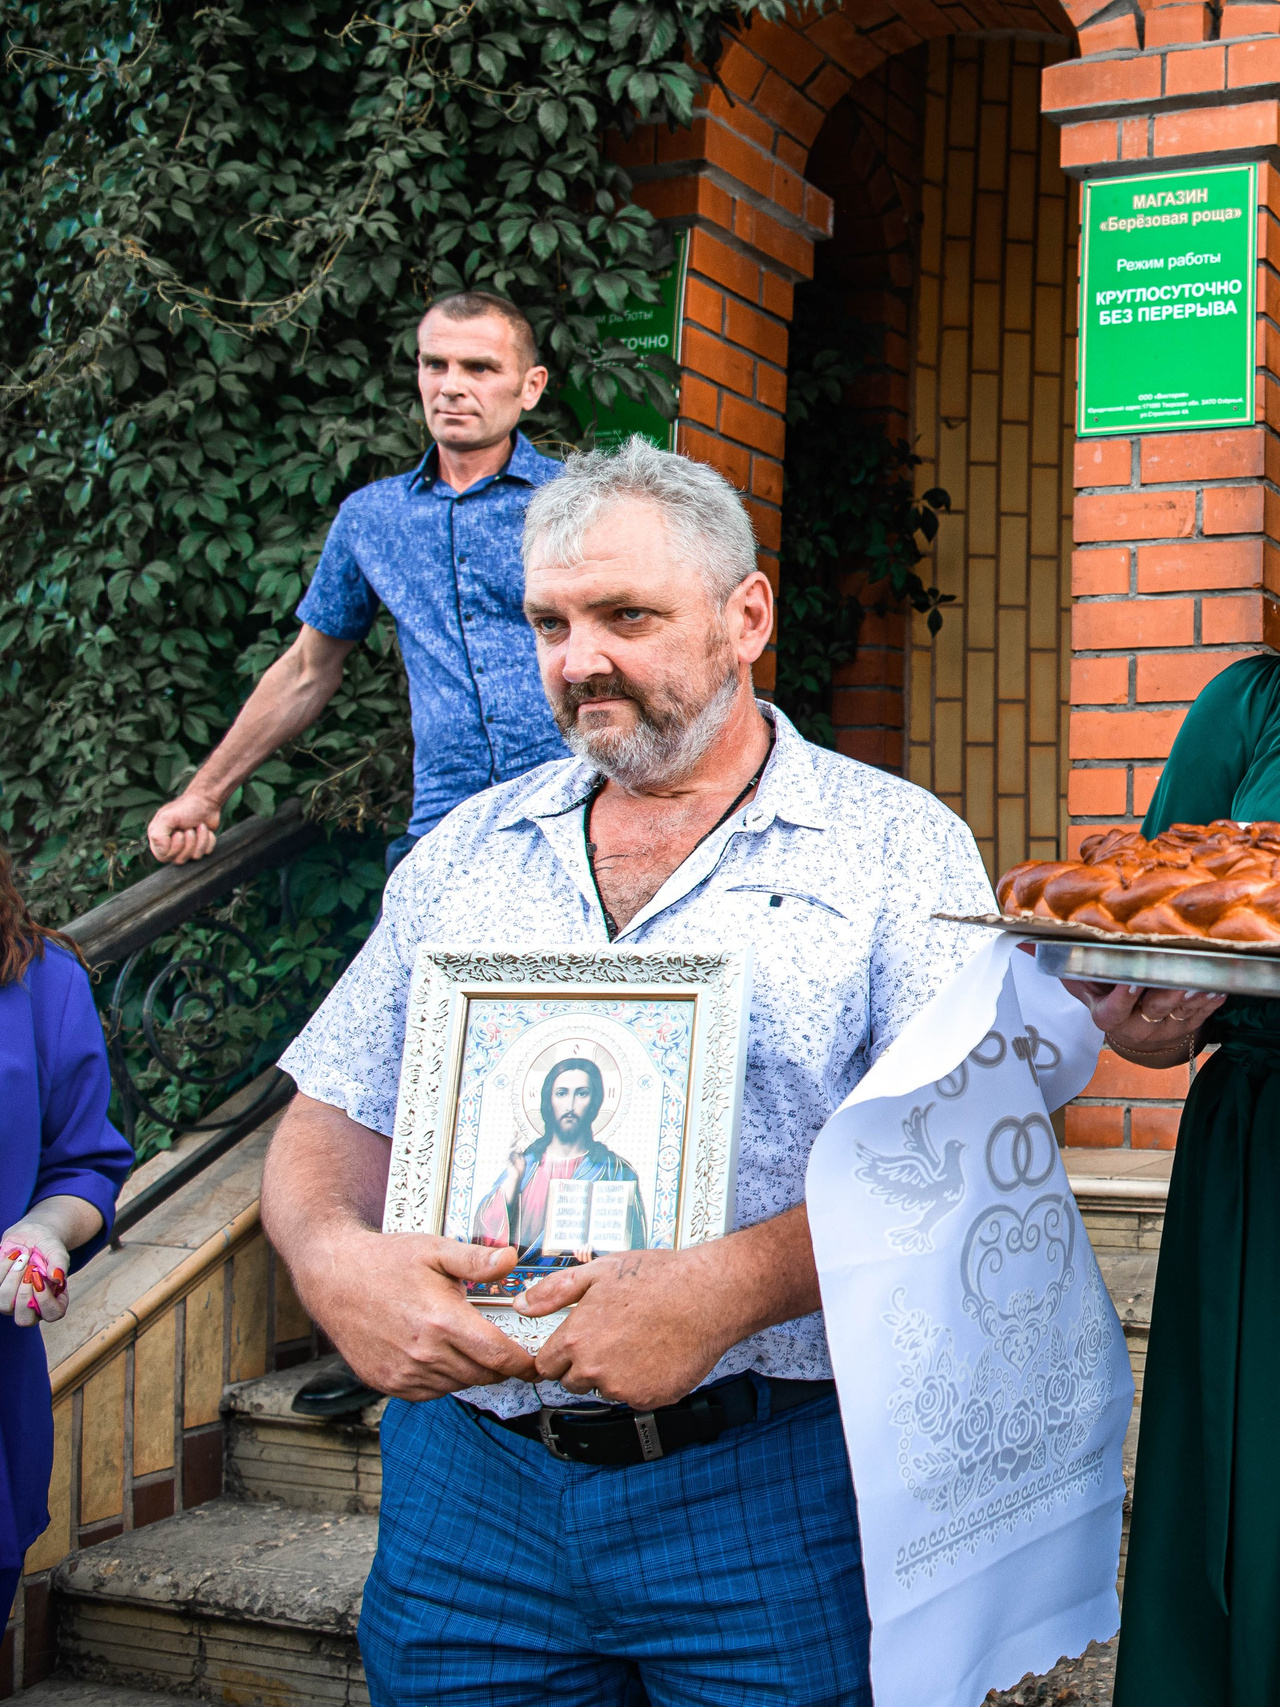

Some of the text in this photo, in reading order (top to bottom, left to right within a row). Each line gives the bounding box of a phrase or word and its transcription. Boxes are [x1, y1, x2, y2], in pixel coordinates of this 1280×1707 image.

[1133, 188, 1208, 209] МАГАЗИН
[1100, 208, 1242, 233] «Берёзовая роща»
[1117, 252, 1221, 272] Режим работы
[1096, 279, 1242, 306] КРУГЛОСУТОЧНО
[1099, 300, 1238, 326] БЕЗ ПЕРЕРЫВА
